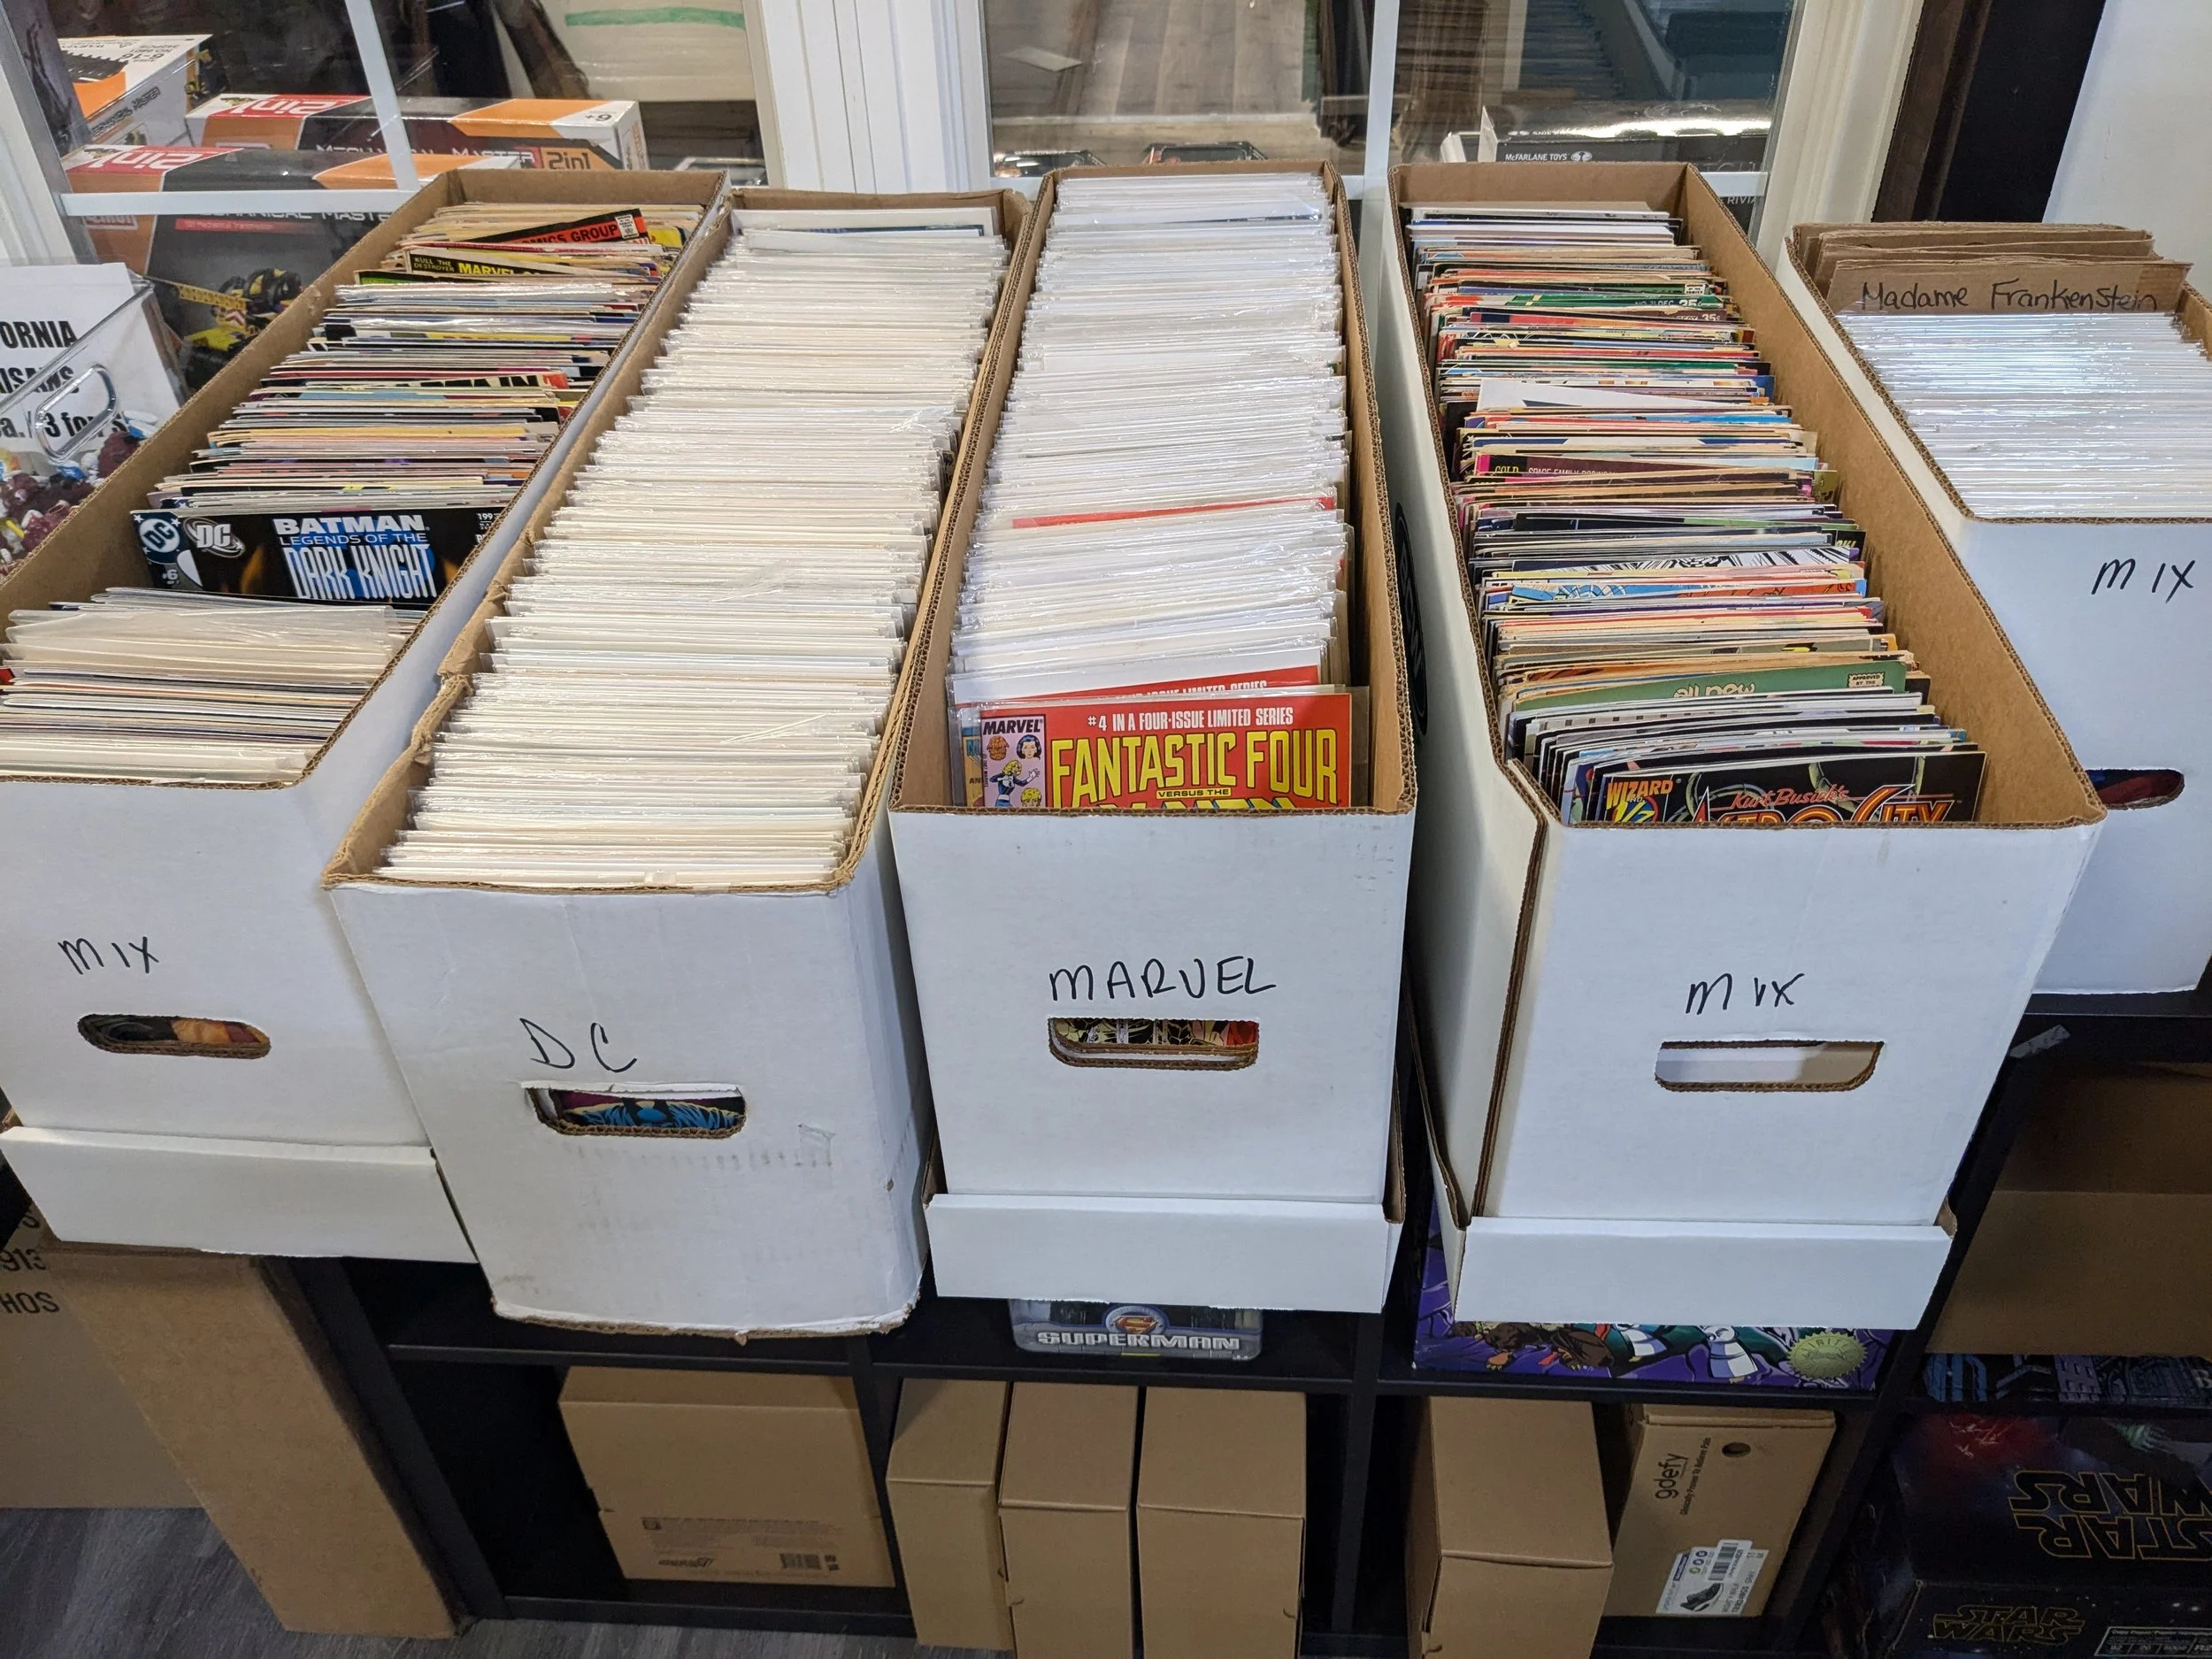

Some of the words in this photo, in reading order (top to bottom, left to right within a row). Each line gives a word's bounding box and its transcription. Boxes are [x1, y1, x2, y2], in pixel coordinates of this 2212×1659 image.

[1549, 152, 1569, 161] TOYS
[570, 223, 618, 243] GROUP
[1860, 280, 1970, 311] Madame
[1990, 276, 2158, 311] Frankenstein
[142, 522, 176, 550] DC
[196, 523, 232, 549] DC
[272, 514, 426, 535] BATMAN
[278, 534, 362, 547] LEGENDS
[365, 533, 389, 543] OF
[395, 533, 428, 543] THE
[281, 545, 356, 600] DARK
[349, 542, 438, 600] KNIGHT
[982, 718, 1041, 736] MARVEL
[1112, 713, 1126, 733] IN
[1127, 713, 1137, 732] A
[1207, 707, 1252, 728] LIMITED
[1255, 706, 1294, 726] SERIES
[1050, 731, 1238, 808] FANTASTIC
[1245, 727, 1340, 806] FOUR
[1157, 789, 1204, 798] VERSUS
[1205, 787, 1230, 797] THE
[1606, 779, 1674, 802] WIZARD
[1729, 789, 1773, 811] Kurt
[1048, 955, 1277, 1002] MARVEL
[518, 1017, 638, 1073] DC
[1037, 1332, 1240, 1350] SUPERMAN
[1654, 1453, 1689, 1501] gdefy
[2007, 1469, 2212, 1517] WARS
[2012, 1512, 2212, 1561] STAR
[1932, 1604, 2085, 1625] STAR
[1932, 1621, 2083, 1646] WARS
